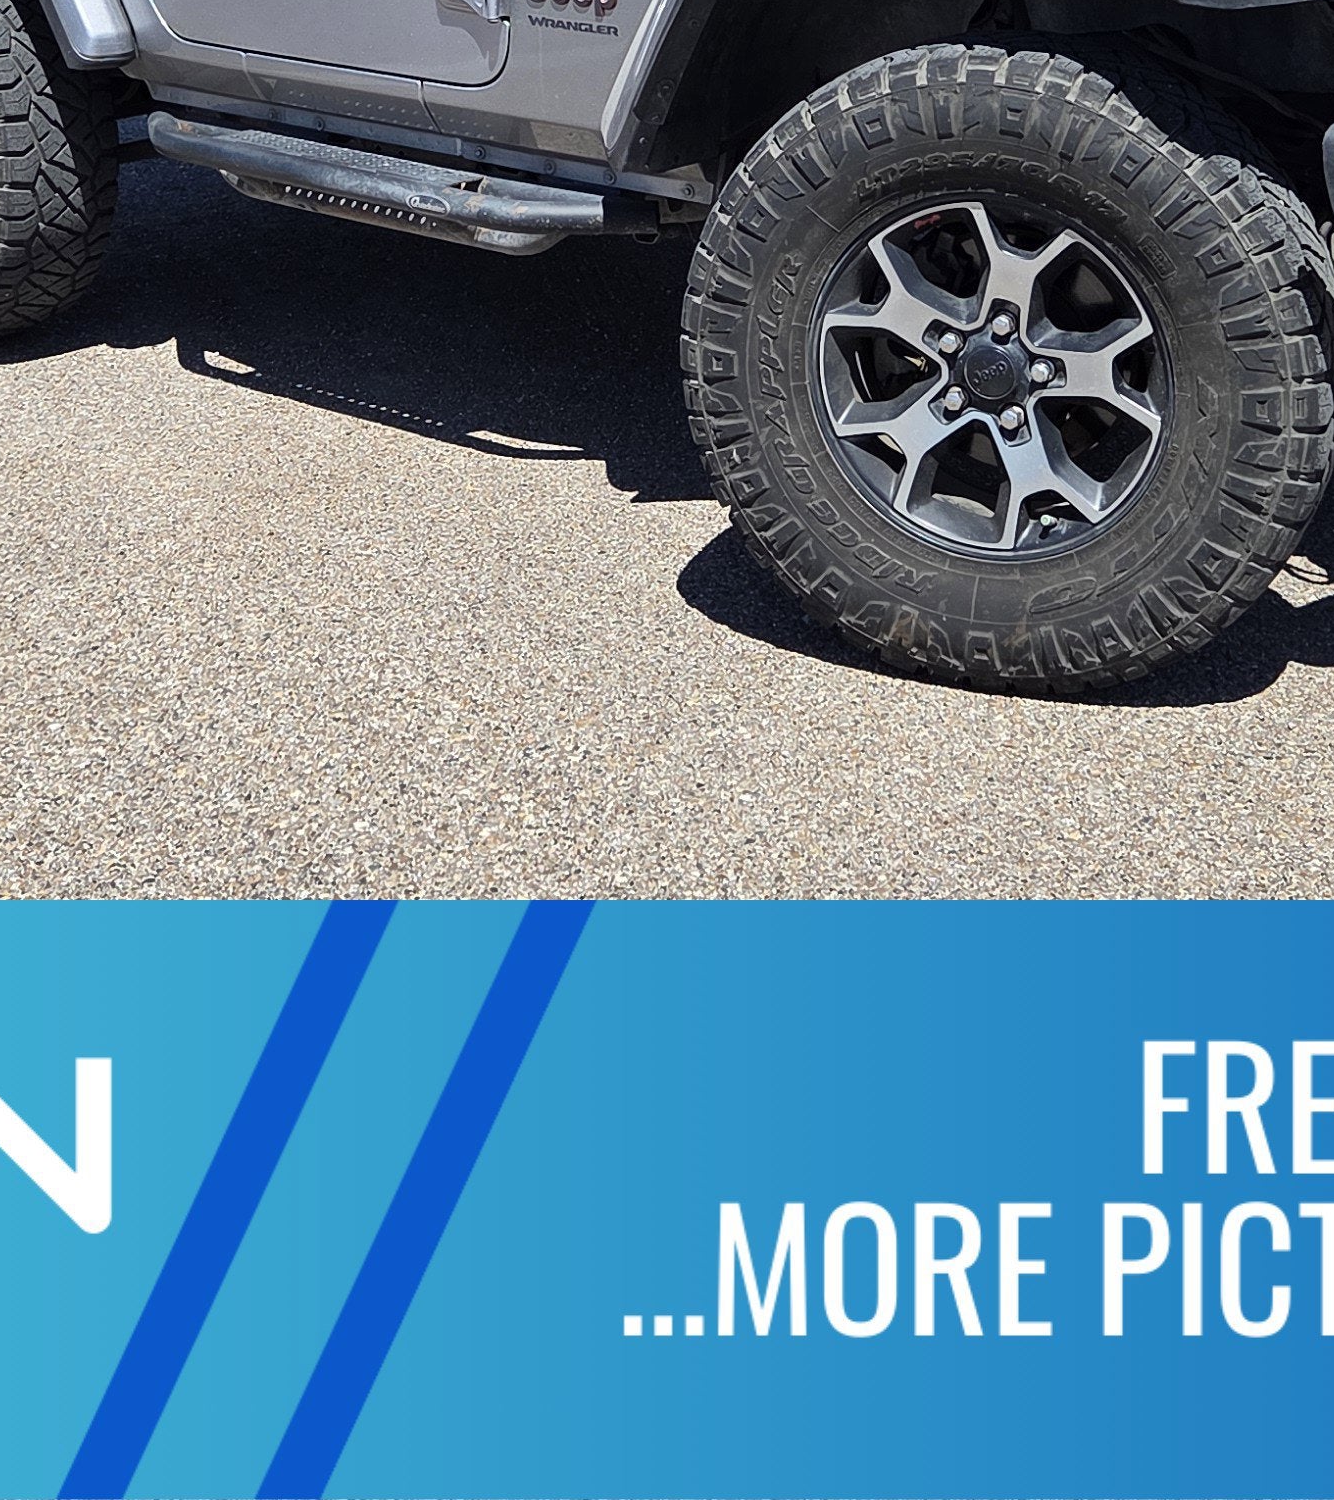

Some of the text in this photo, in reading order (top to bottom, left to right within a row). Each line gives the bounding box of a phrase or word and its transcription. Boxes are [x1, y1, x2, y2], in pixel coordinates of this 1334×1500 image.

[527, 14, 619, 37] WRANGLER
[972, 361, 1008, 385] Jeep
[805, 498, 941, 595] RIDGE
